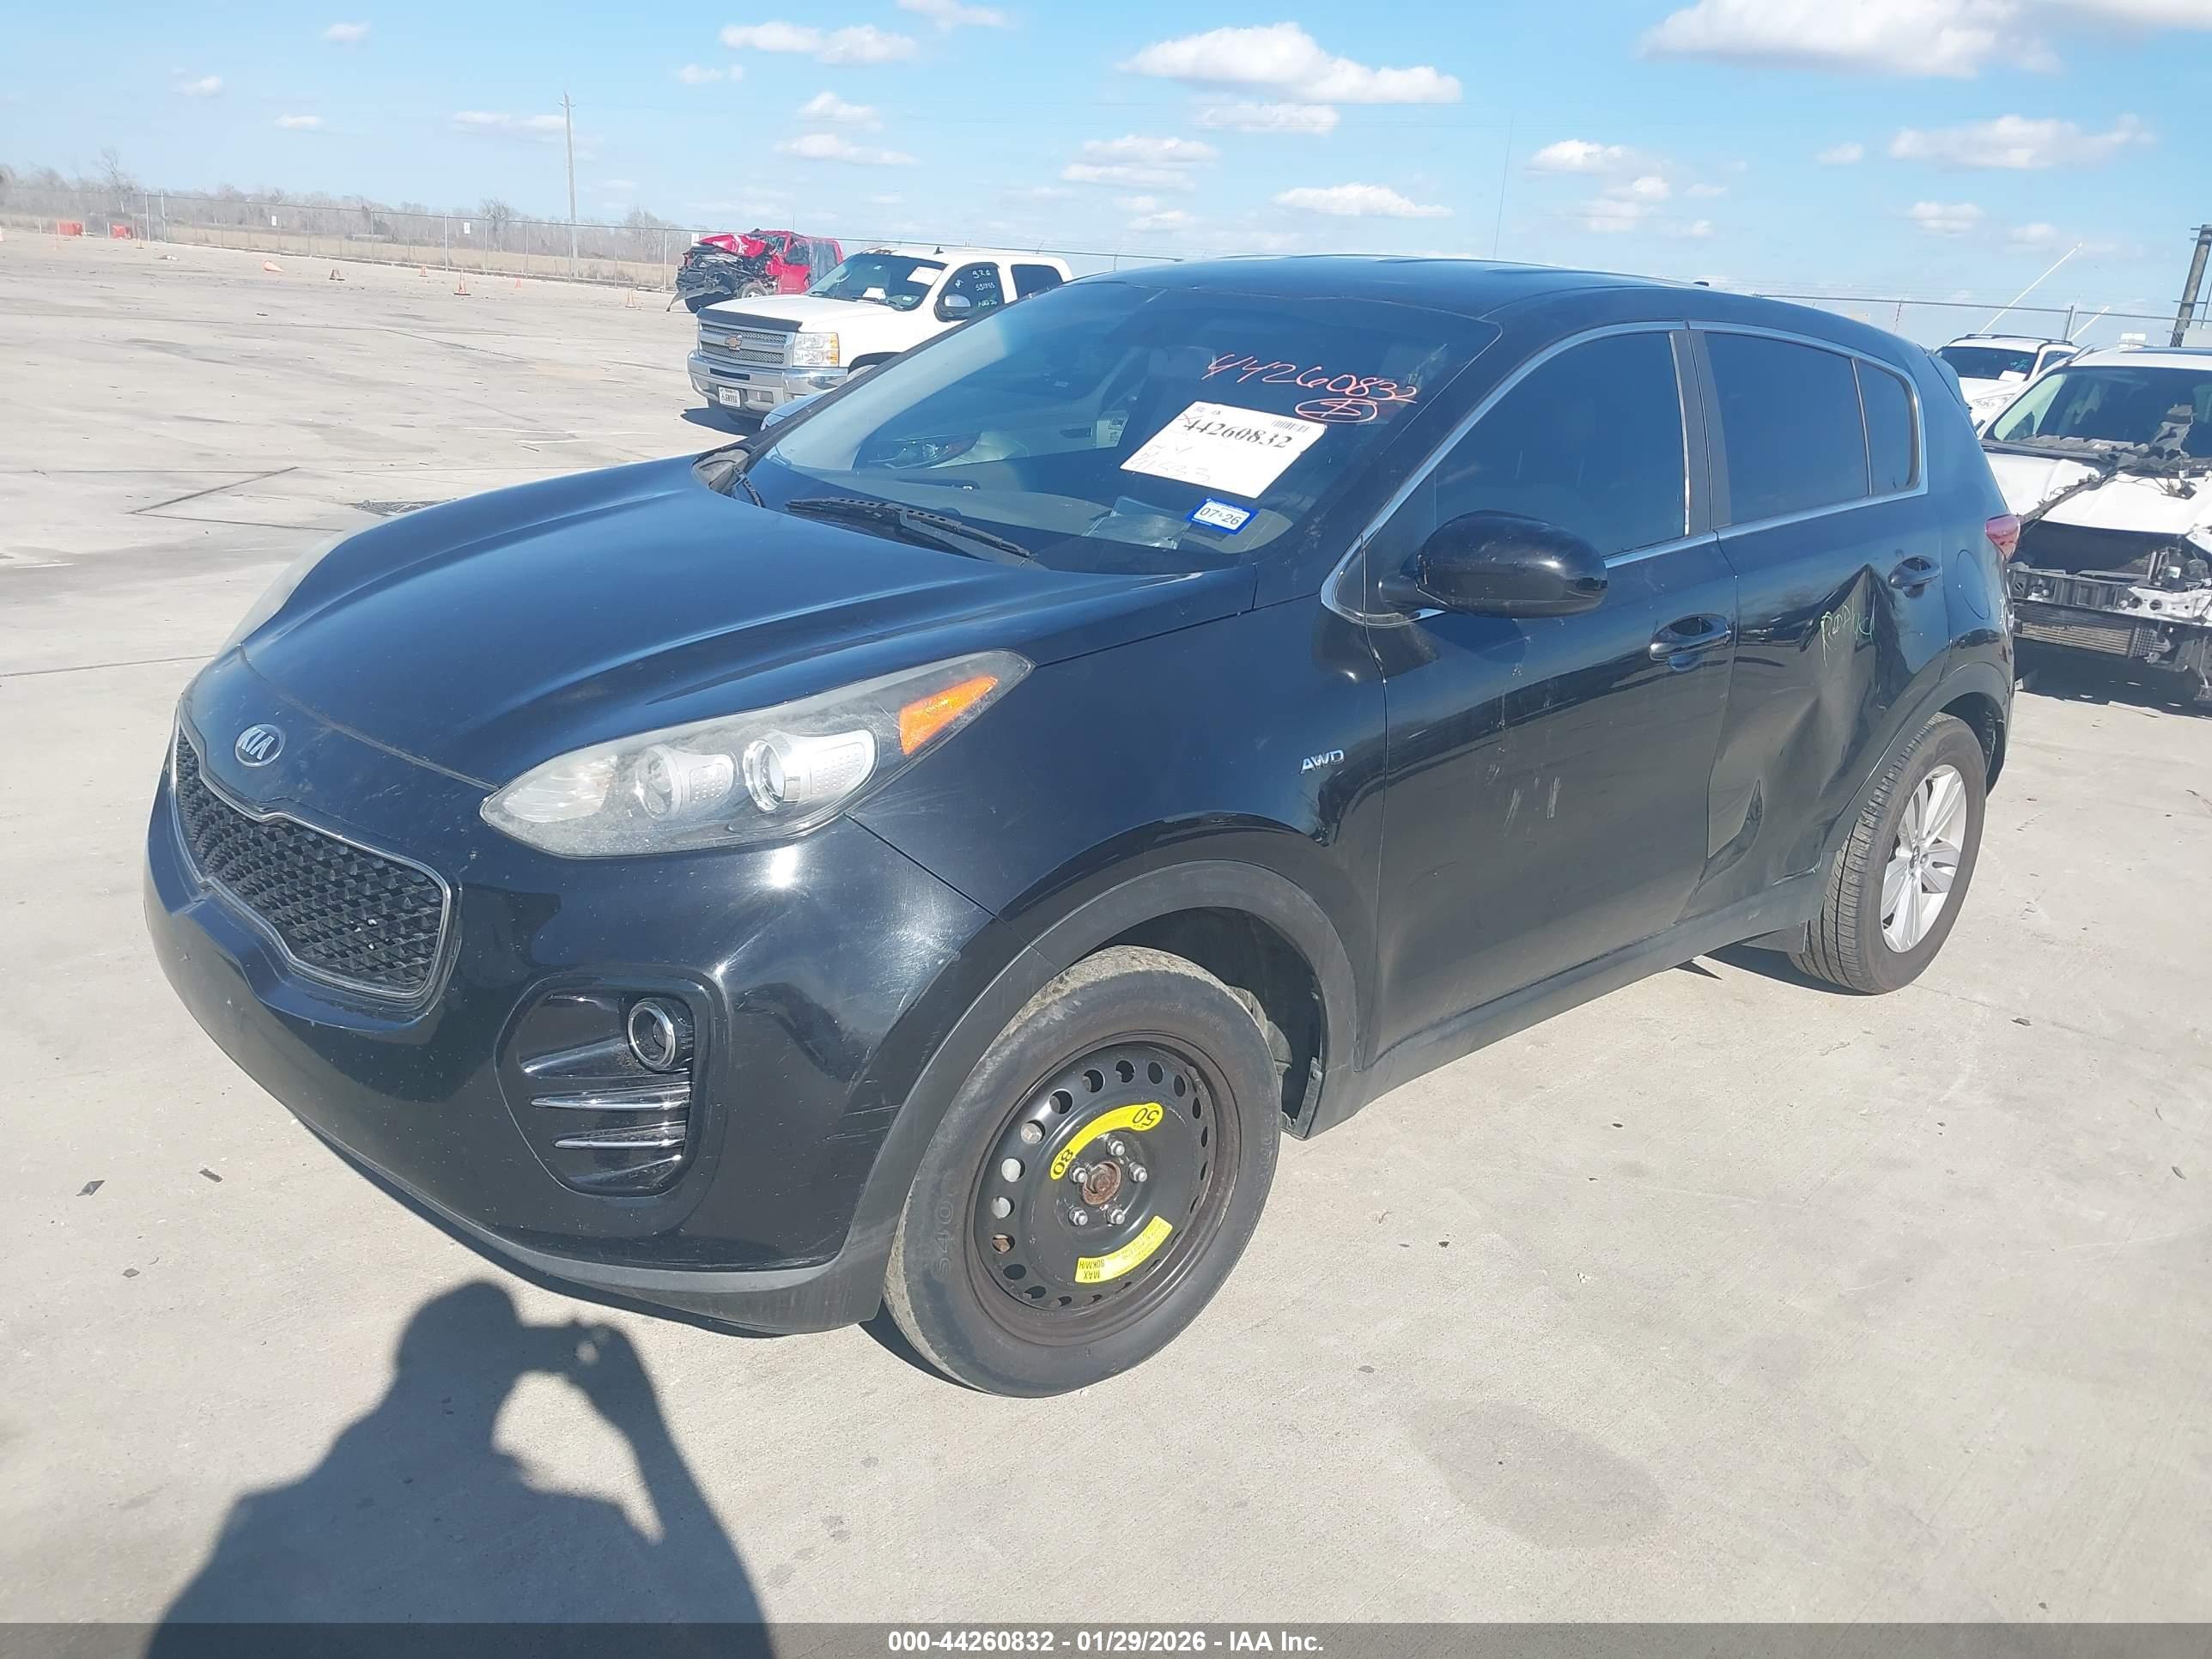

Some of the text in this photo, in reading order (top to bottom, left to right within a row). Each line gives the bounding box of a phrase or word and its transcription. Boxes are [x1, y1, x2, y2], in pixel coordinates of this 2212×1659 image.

[1200, 353, 1418, 404] 44260832
[1183, 418, 1292, 449] 44260832
[239, 726, 276, 762] KIA
[1299, 749, 1345, 775] AWD
[1132, 1106, 1160, 1127] 50
[1052, 1148, 1074, 1176] 80
[1083, 1270, 1100, 1279] MAX
